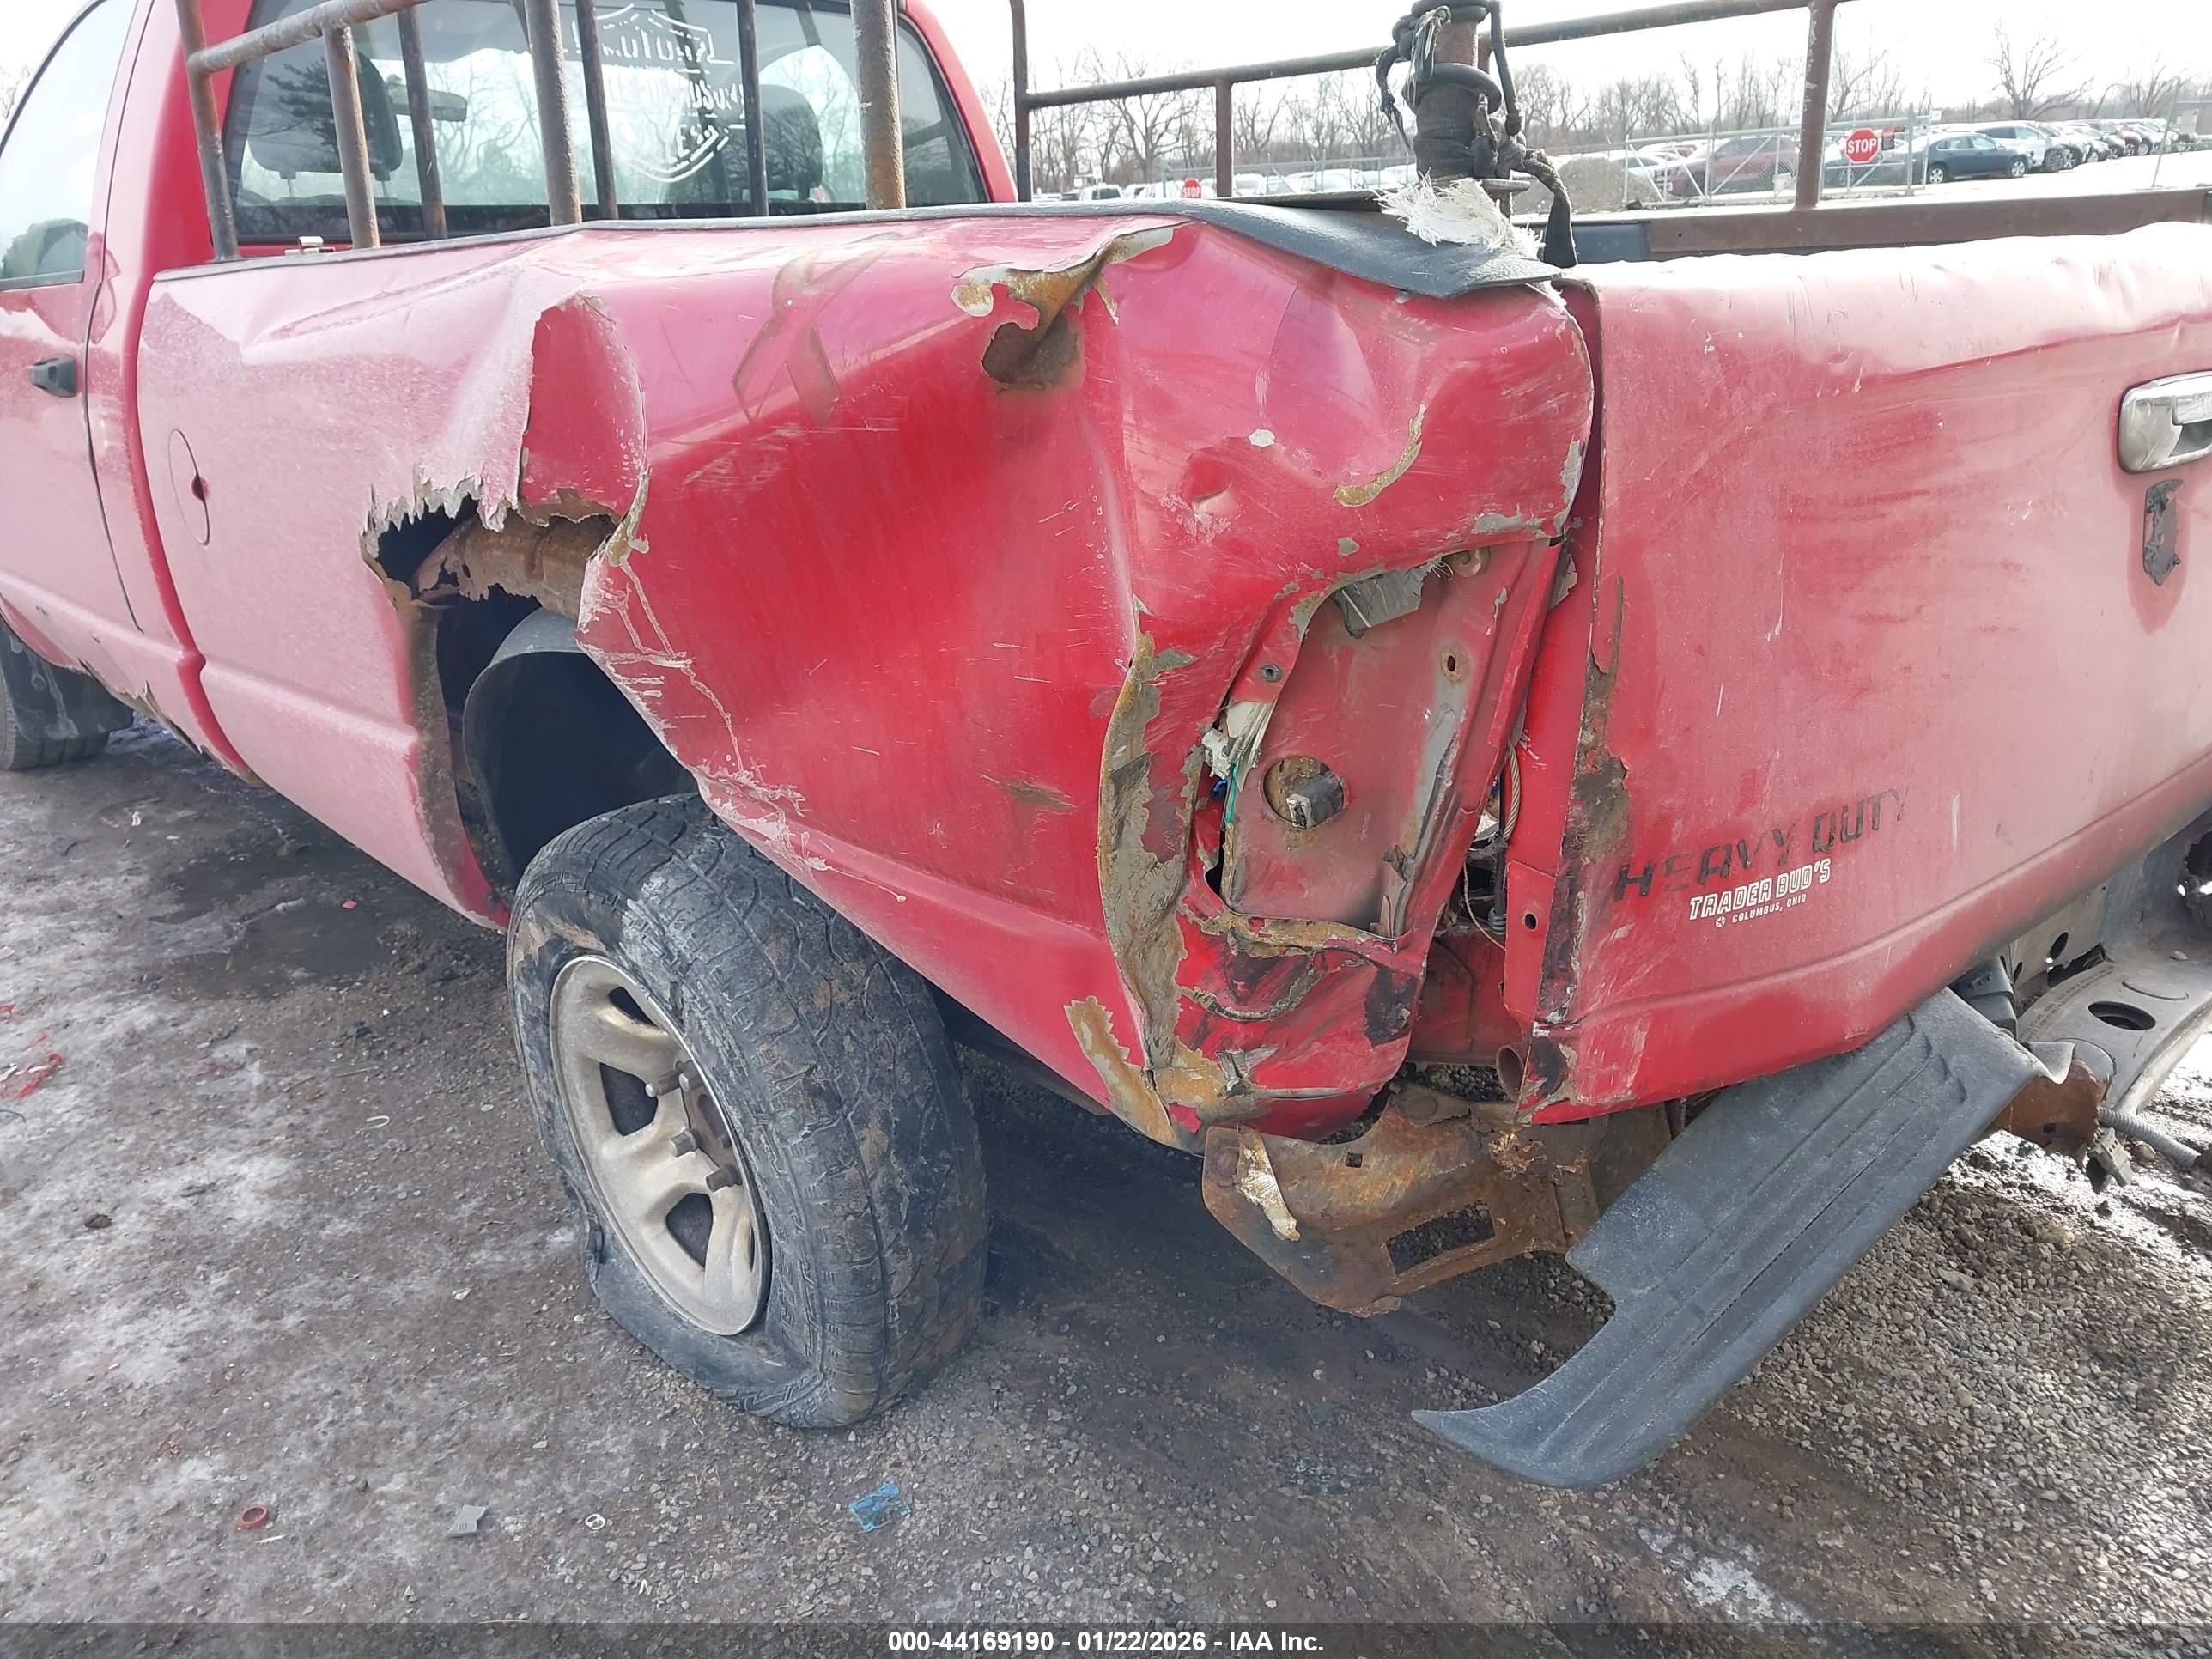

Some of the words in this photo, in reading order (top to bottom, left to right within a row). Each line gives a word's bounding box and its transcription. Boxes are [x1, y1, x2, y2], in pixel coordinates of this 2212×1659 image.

[1848, 138, 1877, 154] STOP
[1182, 186, 1201, 198] STOP
[1614, 823, 1796, 901] HEAVY
[1813, 783, 1911, 854] DUTY
[1689, 878, 1773, 921] TRADER
[1776, 858, 1832, 899] BUD'S
[1731, 902, 1784, 924] COLUMBUS,
[1786, 893, 1808, 908] OHIO
